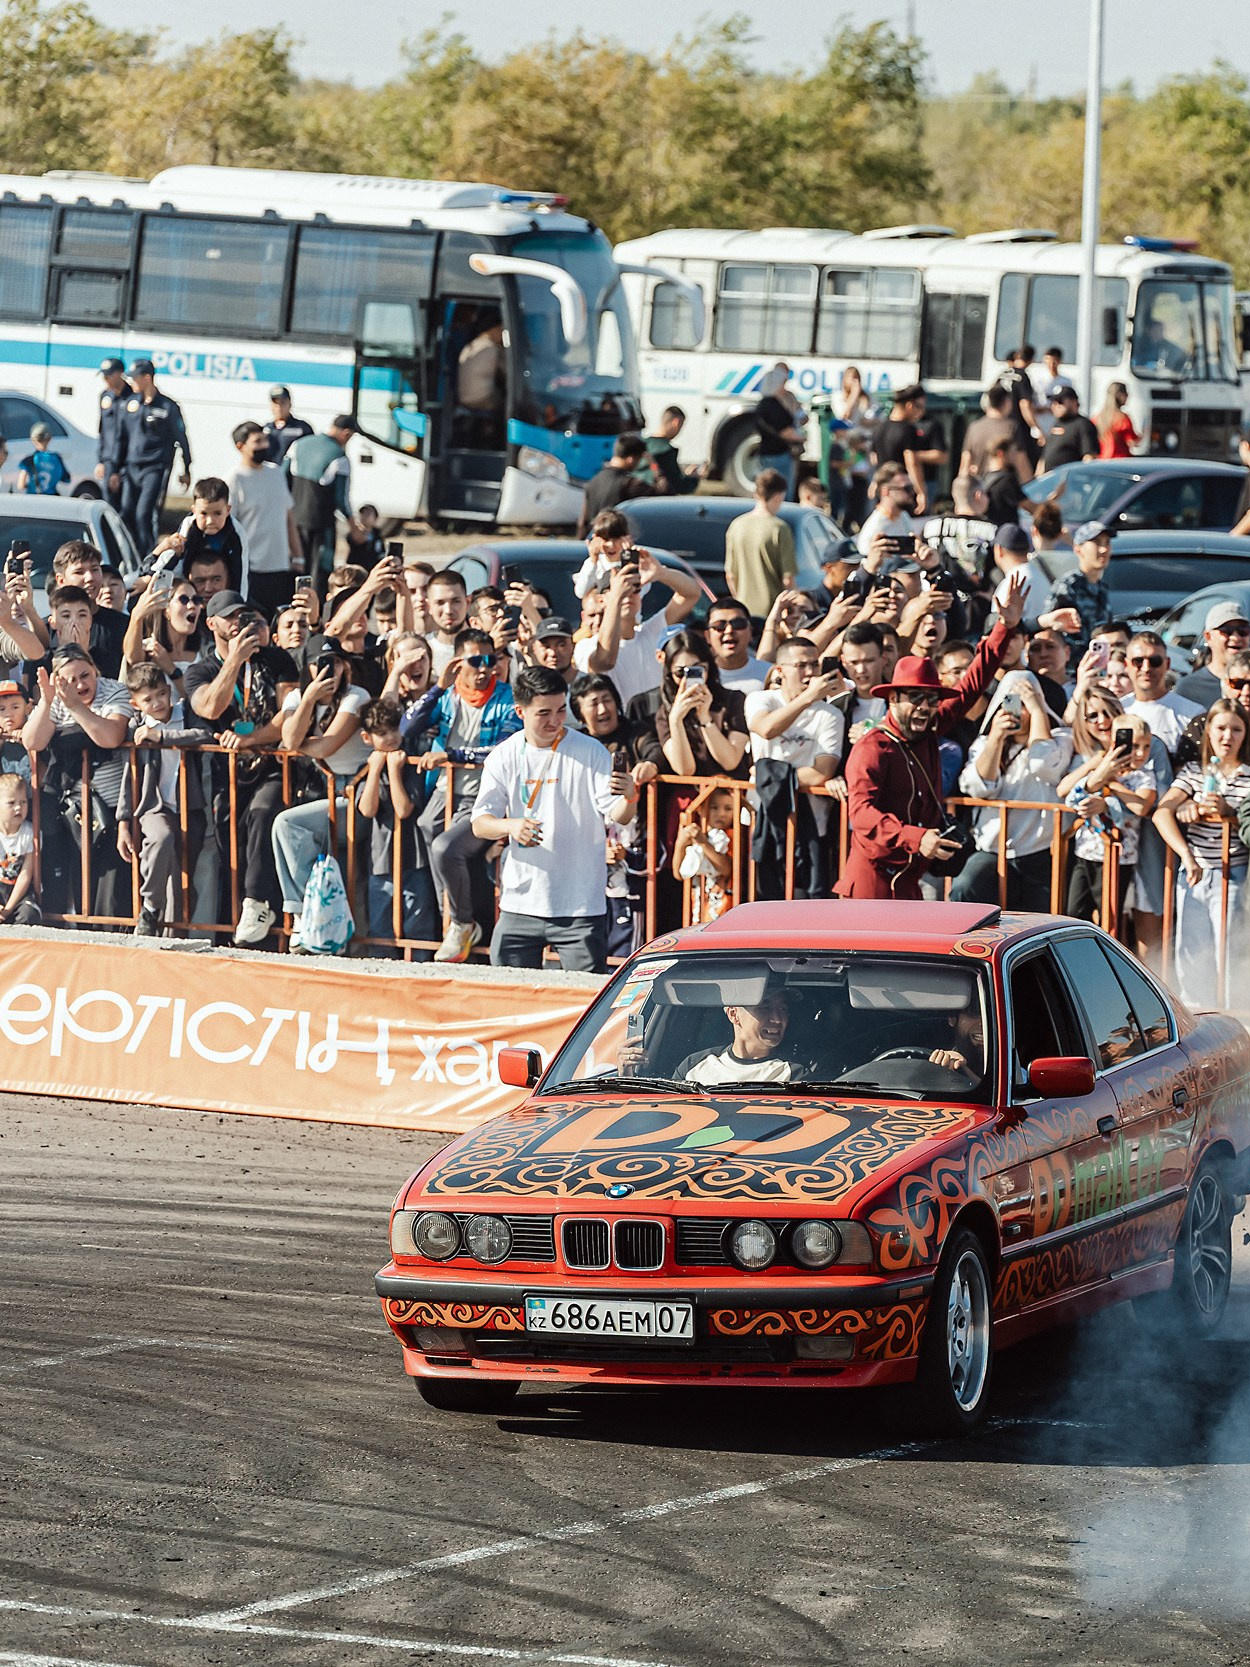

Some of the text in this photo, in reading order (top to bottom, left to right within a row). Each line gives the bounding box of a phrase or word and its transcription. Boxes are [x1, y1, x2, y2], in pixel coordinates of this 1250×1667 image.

[151, 350, 258, 381] POLISIA
[529, 1316, 547, 1329] KZ
[658, 1306, 692, 1334] 07
